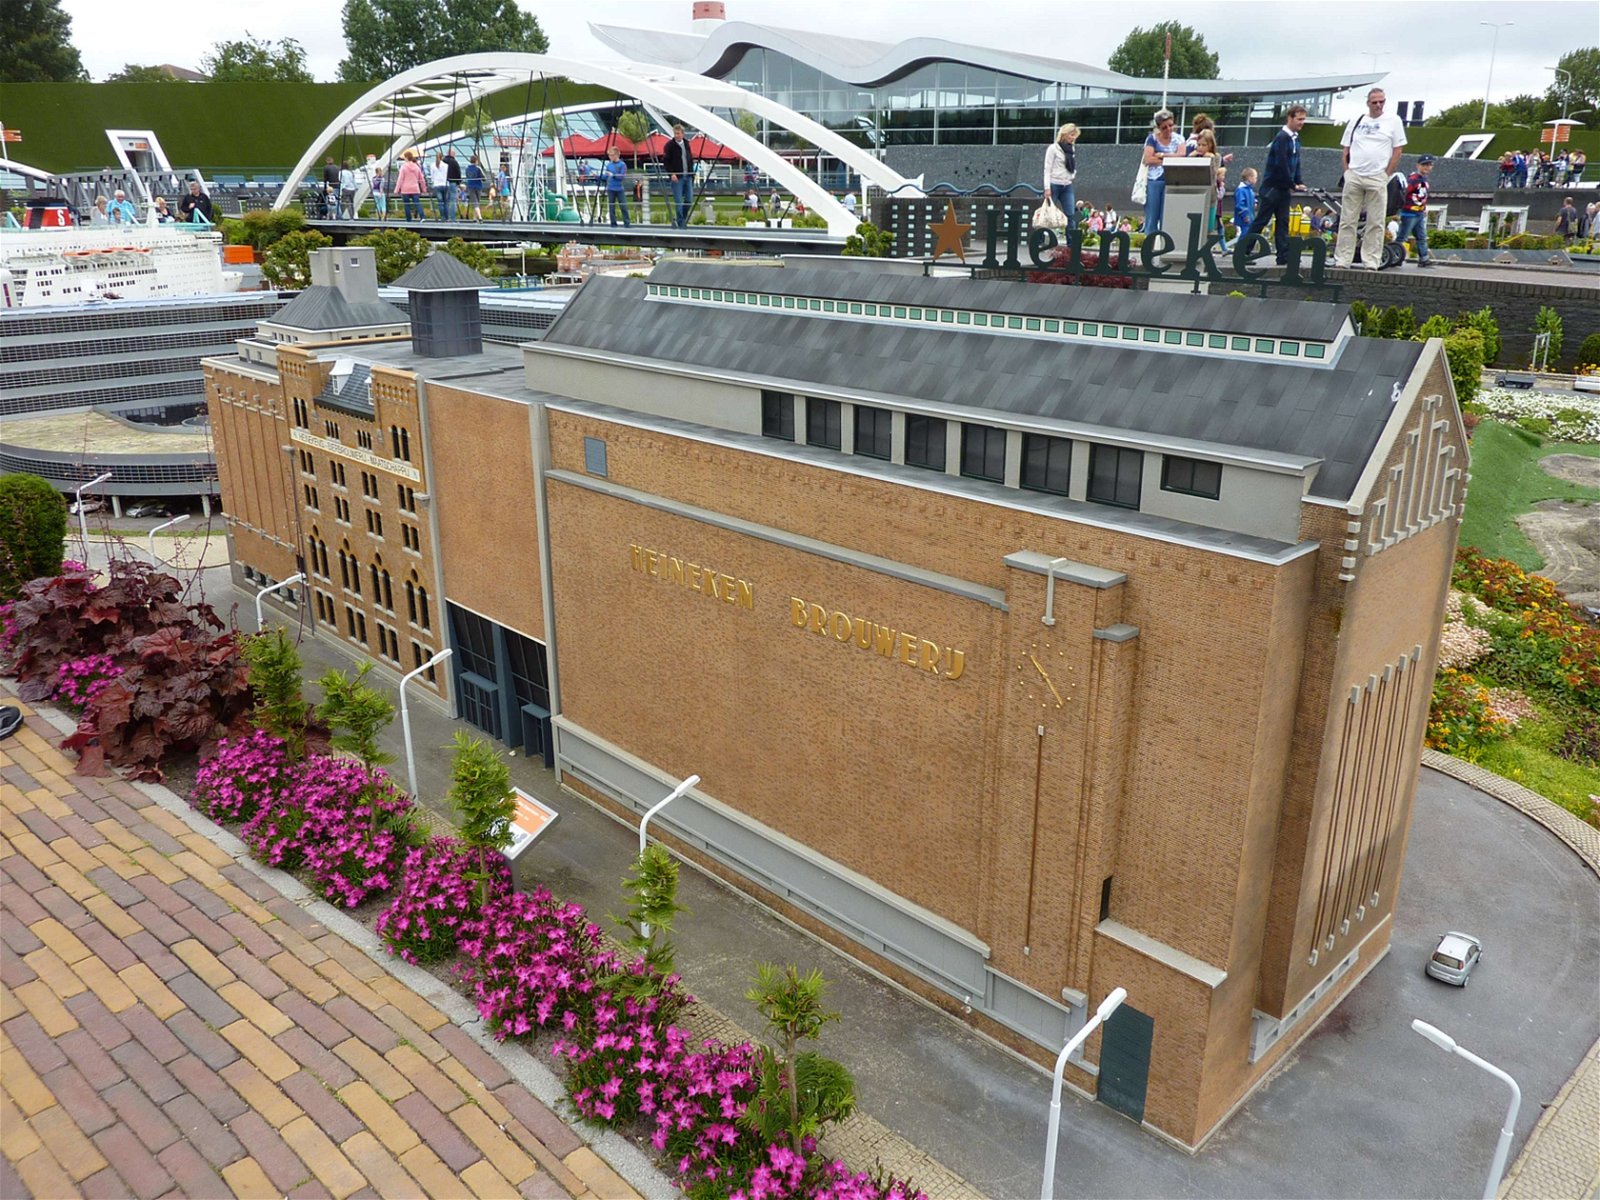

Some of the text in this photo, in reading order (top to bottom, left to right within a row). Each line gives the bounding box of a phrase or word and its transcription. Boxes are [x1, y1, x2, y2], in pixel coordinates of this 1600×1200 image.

[57, 209, 66, 226] S
[982, 208, 1331, 284] Heineken
[630, 543, 753, 610] HEINEKEN
